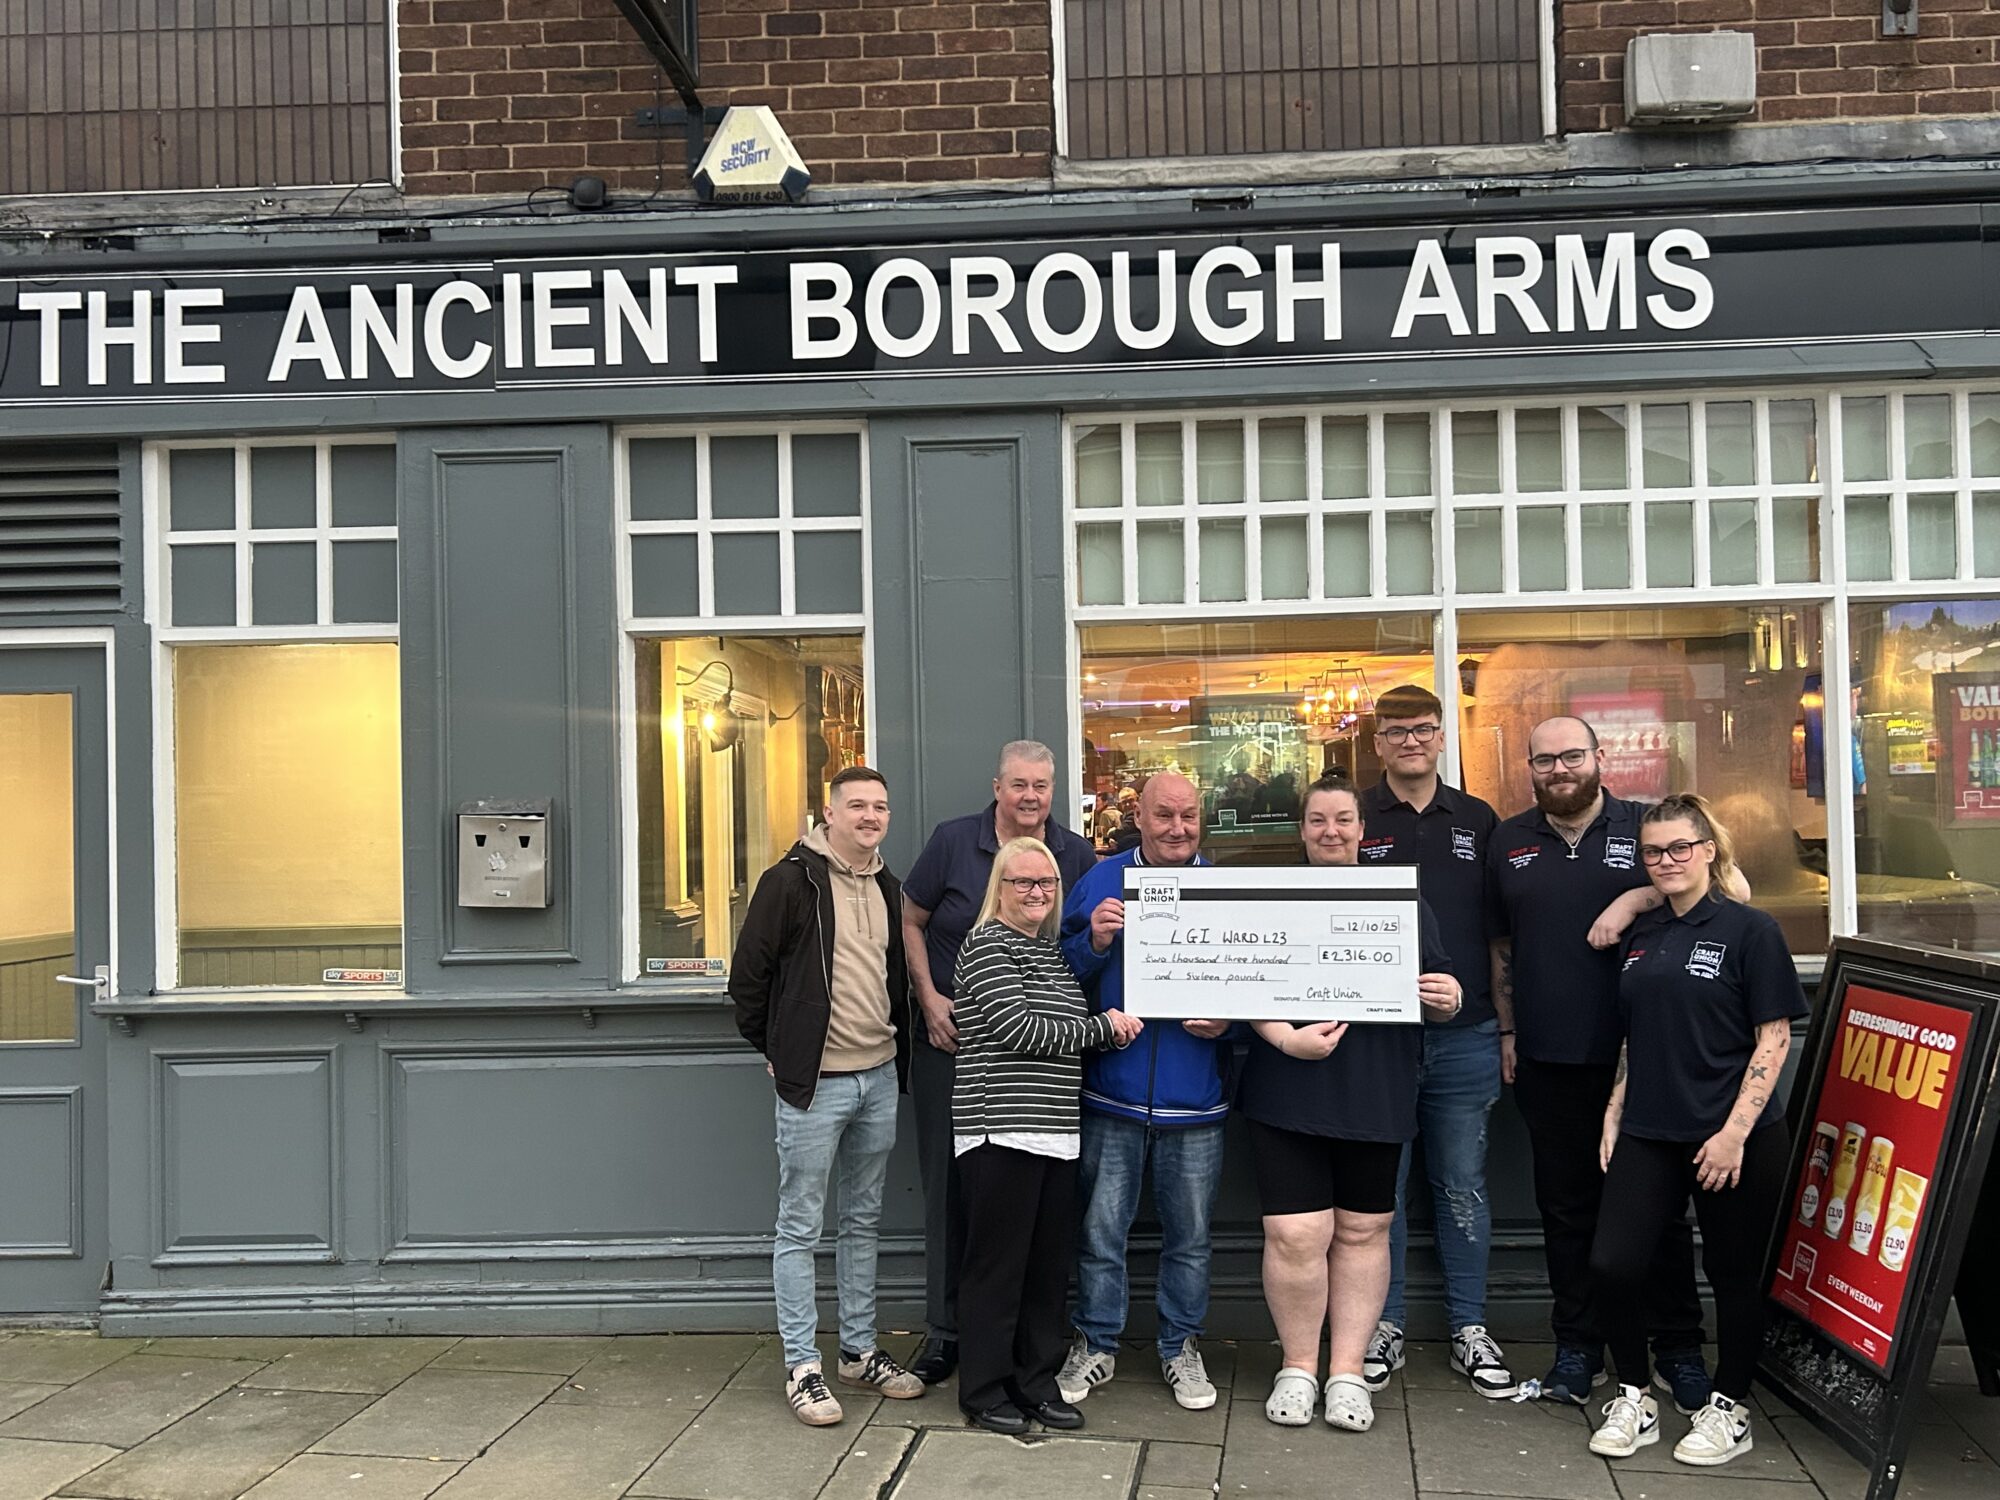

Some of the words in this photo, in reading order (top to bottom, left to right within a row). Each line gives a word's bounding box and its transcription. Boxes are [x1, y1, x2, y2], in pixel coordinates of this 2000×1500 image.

[731, 137, 756, 156] HCW
[720, 148, 771, 173] SECURITY
[18, 288, 226, 387] THE
[267, 264, 739, 382] ANCIENT
[789, 241, 1344, 361] BOROUGH
[1390, 228, 1715, 338] ARMS
[1208, 726, 1230, 737] THE
[1144, 887, 1174, 895] CRAFT
[1144, 895, 1175, 903] UNION
[1347, 920, 1398, 932] 12/10/25
[1222, 930, 1259, 944] WARD
[1263, 931, 1288, 946] L23
[1145, 953, 1167, 964] two
[1171, 953, 1220, 964] thousand
[1224, 953, 1248, 964] three
[1251, 954, 1291, 965] hundred
[1693, 954, 1719, 964] UNION
[1695, 949, 1721, 958] CRAFT
[650, 961, 665, 970] sky
[667, 960, 706, 969] SPORTS
[326, 971, 342, 980] sky
[343, 971, 382, 981] SPORTS
[1154, 971, 1172, 981] and
[1225, 971, 1266, 986] pounds
[1306, 986, 1331, 1001] Craft
[1333, 987, 1363, 999] Union
[1847, 1008, 1920, 1041] REFRESHINGLY
[1919, 1028, 1957, 1051] GOOD
[1839, 1025, 1952, 1110] VALUE
[1827, 1207, 1843, 1219] £3.10
[1854, 1221, 1873, 1234] £3.30
[1885, 1236, 1905, 1251] £2.90
[1827, 1274, 1851, 1295] EVERY
[1849, 1285, 1884, 1314] WEEKDAY
